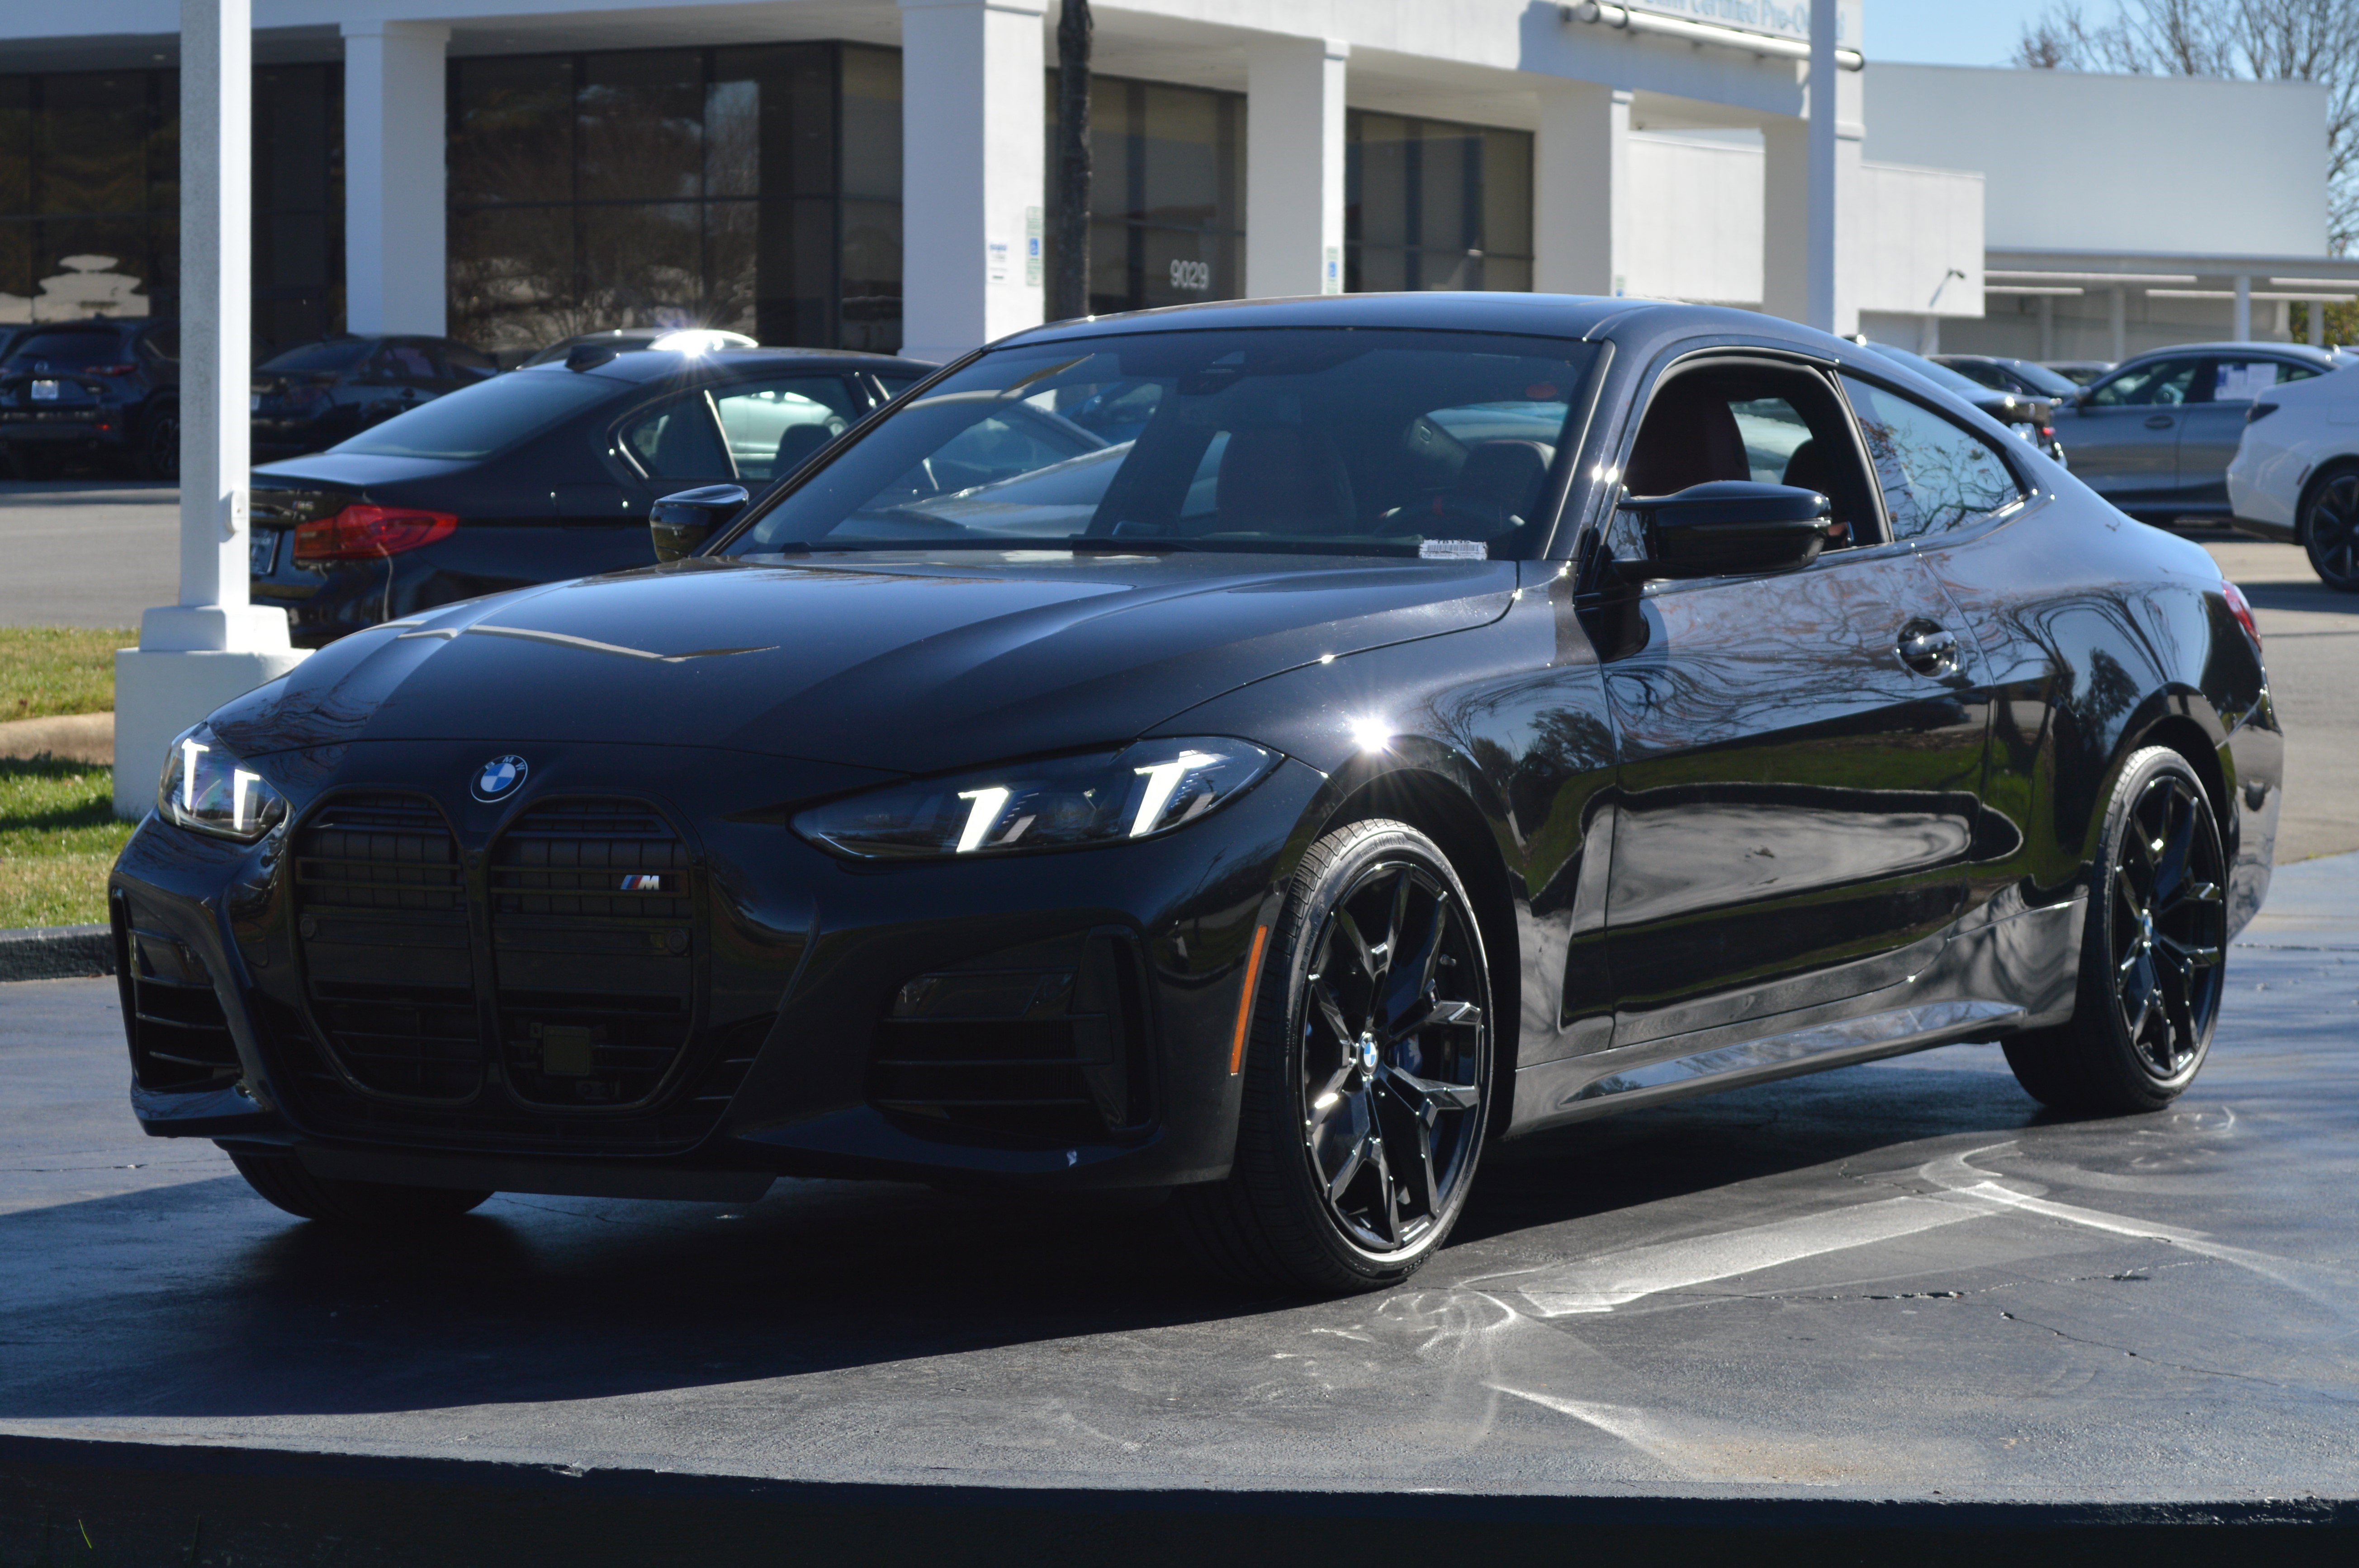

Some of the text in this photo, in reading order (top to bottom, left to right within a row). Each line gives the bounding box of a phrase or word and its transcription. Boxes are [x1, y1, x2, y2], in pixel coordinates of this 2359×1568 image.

[1170, 259, 1209, 289] 9029
[485, 756, 526, 770] BMW
[636, 874, 659, 890] M
